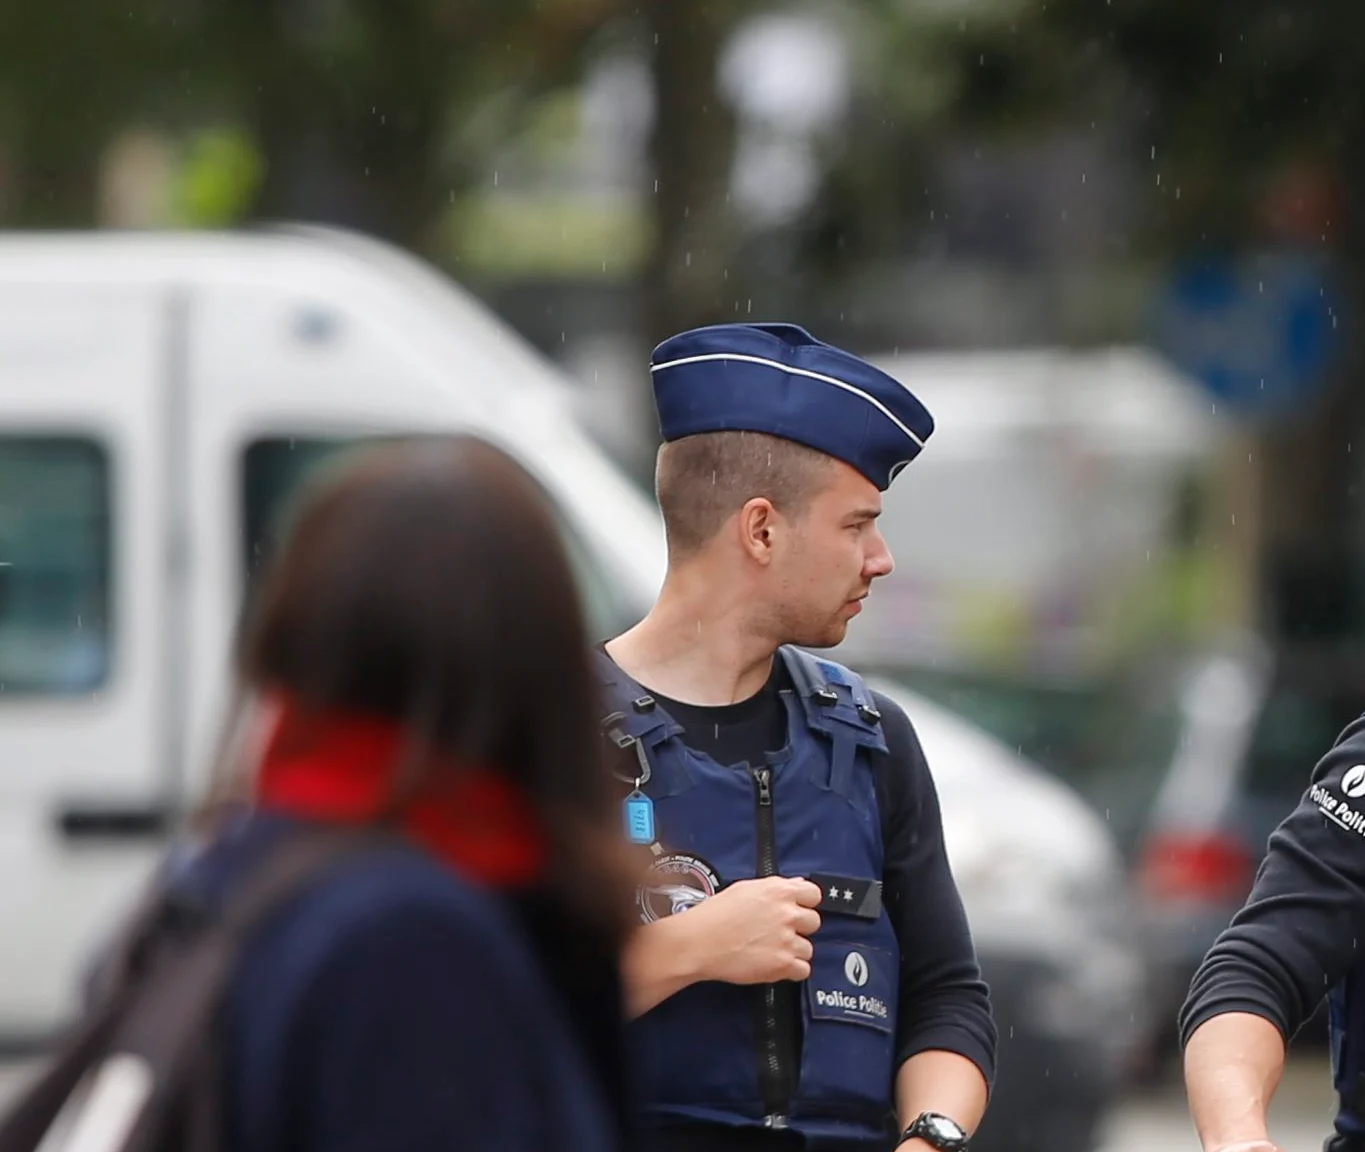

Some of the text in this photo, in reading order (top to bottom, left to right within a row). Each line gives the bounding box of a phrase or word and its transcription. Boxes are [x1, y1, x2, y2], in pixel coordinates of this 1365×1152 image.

[1309, 783, 1338, 811] Police
[816, 990, 888, 1019] Police Politie
